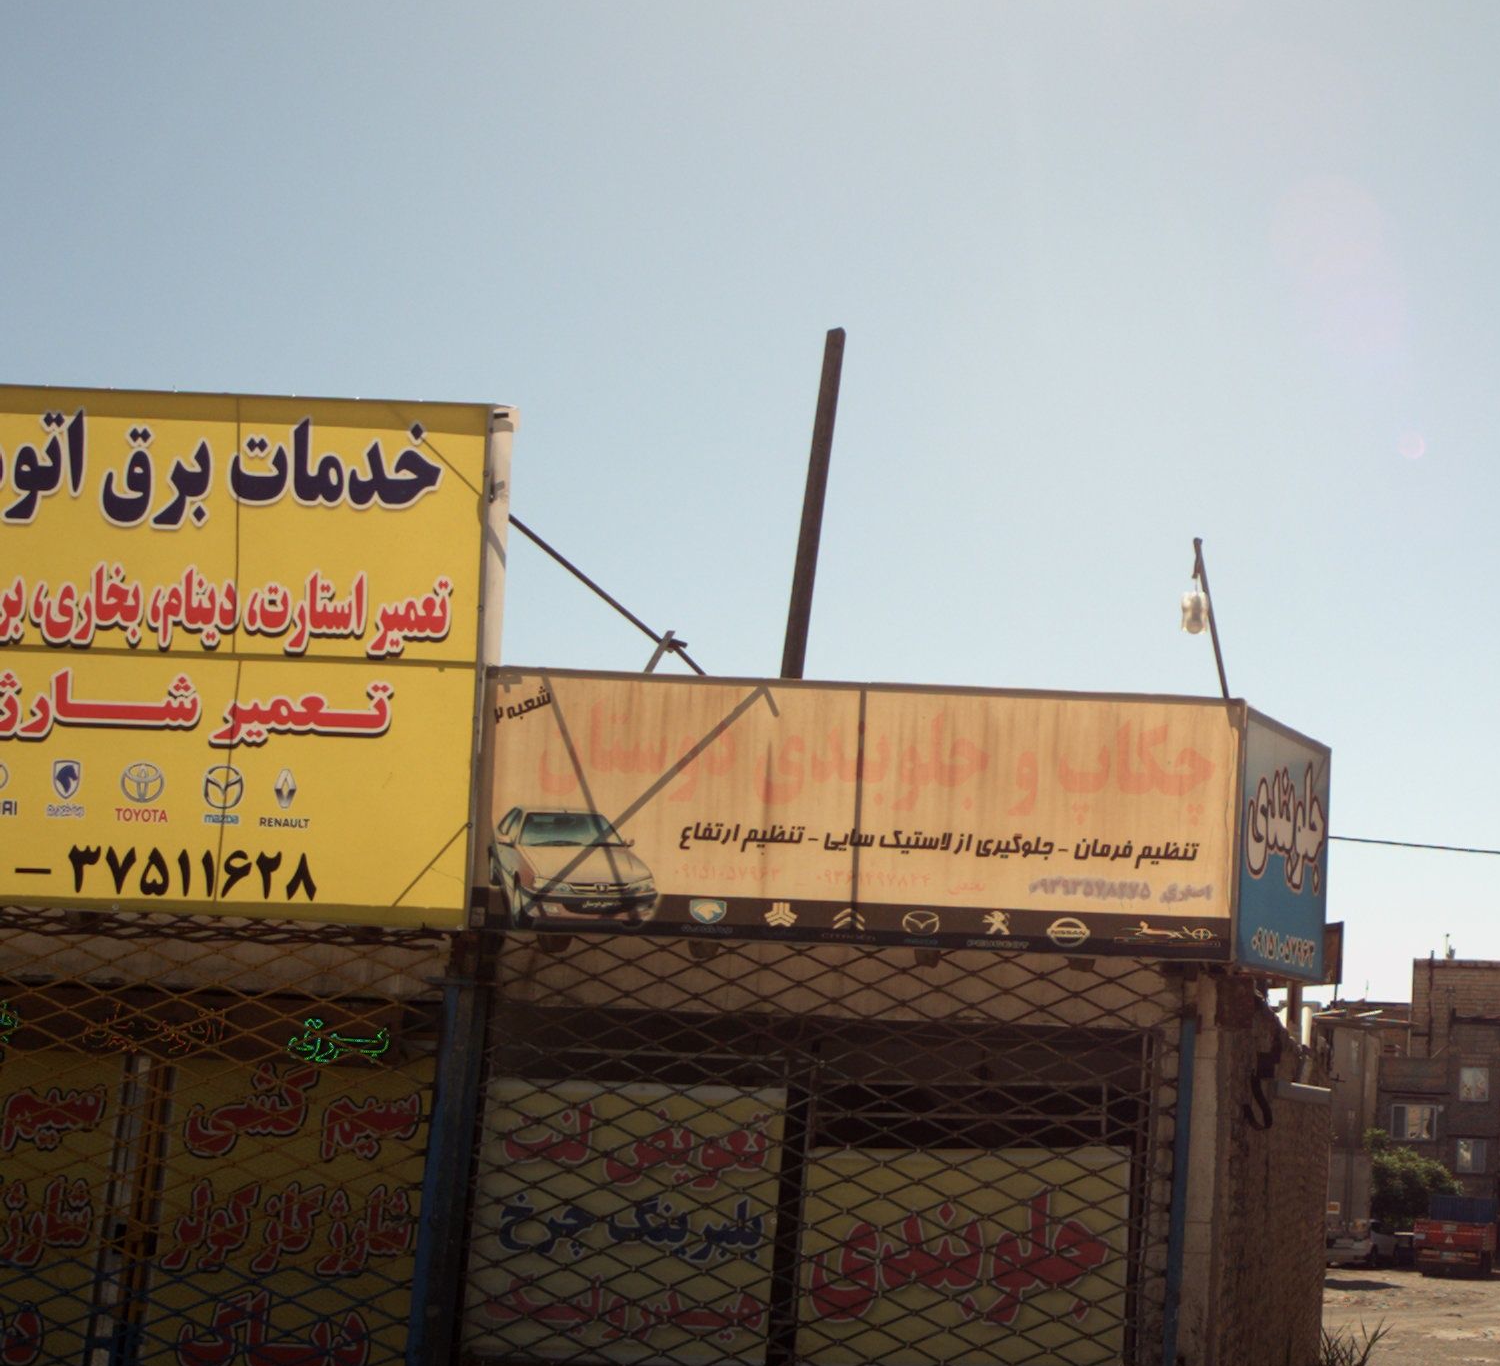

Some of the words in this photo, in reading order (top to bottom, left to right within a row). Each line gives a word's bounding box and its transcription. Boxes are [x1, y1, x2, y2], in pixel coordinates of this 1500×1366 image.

[0, 408, 86, 523] اتو
[102, 425, 211, 527] برق
[230, 418, 442, 507] خدمات
[366, 579, 453, 656] تعمیر
[208, 681, 393, 747] تعمیر
[507, 685, 551, 720] شعبه
[1006, 750, 1040, 816] و
[1057, 719, 1216, 826] چکاپ
[115, 808, 168, 824] TOYOTA
[259, 816, 310, 829] RENAULT
[680, 821, 740, 851] ارتفاع
[741, 824, 806, 853] تنظیم
[976, 834, 1055, 859] جلوگیری
[1074, 838, 1133, 861] فرمان
[1245, 758, 1326, 896] جلوبندی
[67, 844, 318, 902] ۳۷۵۱۱۶۲۸
[1135, 841, 1200, 869] تنظیم
[1049, 928, 1087, 937] NISSAN
[184, 1061, 321, 1158] کشی
[321, 1092, 422, 1160] سیم
[501, 1101, 593, 1168] لنت
[605, 1112, 770, 1190] تعویض
[160, 1178, 261, 1272] کولر
[315, 1185, 415, 1275] شارژ
[497, 1190, 597, 1255] چرخ
[606, 1196, 767, 1265] بلبرینگ
[808, 1183, 1109, 1325] جلوبندی
